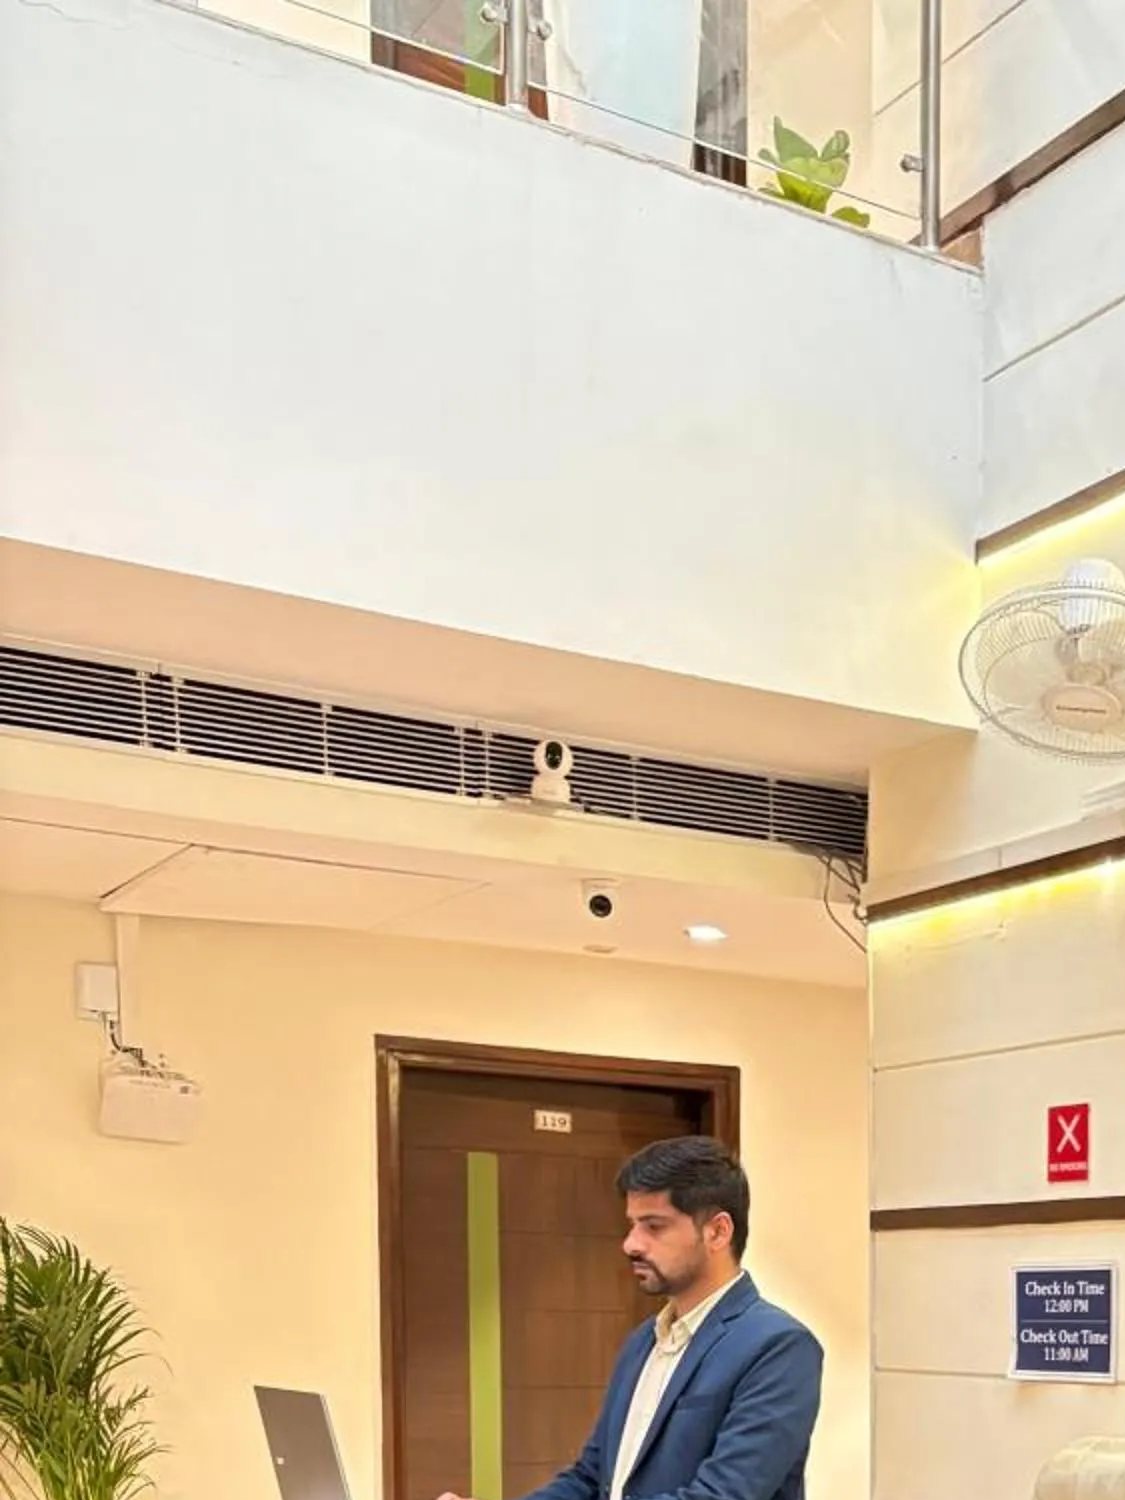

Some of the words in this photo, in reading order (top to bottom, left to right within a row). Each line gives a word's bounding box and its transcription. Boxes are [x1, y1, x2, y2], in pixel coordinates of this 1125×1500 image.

[1025, 1281, 1061, 1296] Check
[1063, 1281, 1075, 1296] In
[1076, 1281, 1105, 1296] Time
[1045, 1299, 1072, 1313] 12:00
[1073, 1299, 1089, 1313] PM
[1020, 1328, 1057, 1344] Check
[1059, 1329, 1079, 1344] Out
[1080, 1329, 1108, 1345] Time
[1044, 1347, 1071, 1361] 11:00
[1072, 1347, 1089, 1362] AM
